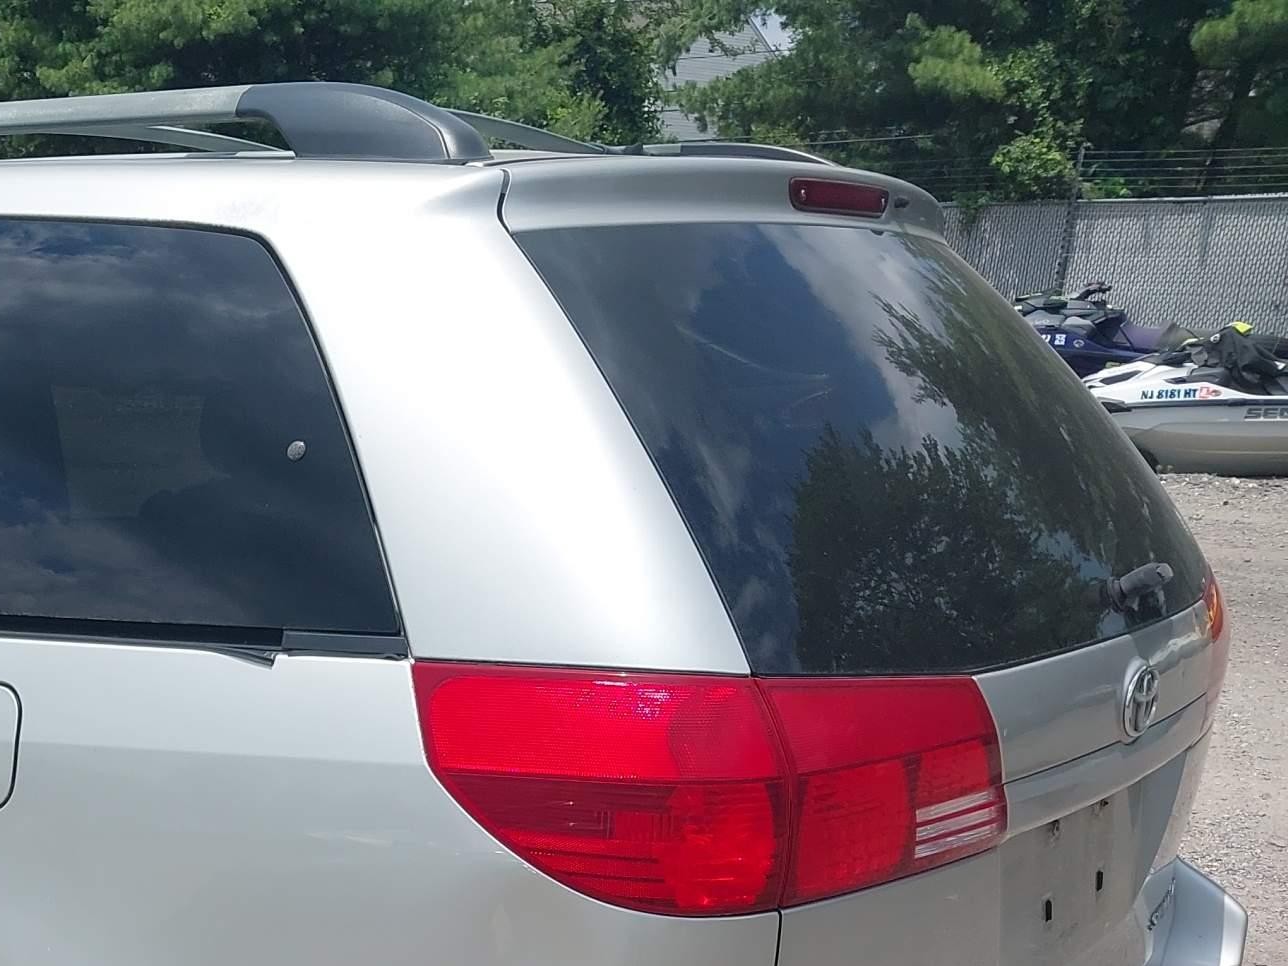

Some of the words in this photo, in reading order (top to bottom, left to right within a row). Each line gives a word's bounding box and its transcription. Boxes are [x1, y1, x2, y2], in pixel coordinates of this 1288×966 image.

[1141, 389, 1154, 400] NJ
[1157, 388, 1181, 399] 8181
[1183, 388, 1198, 398] HT
